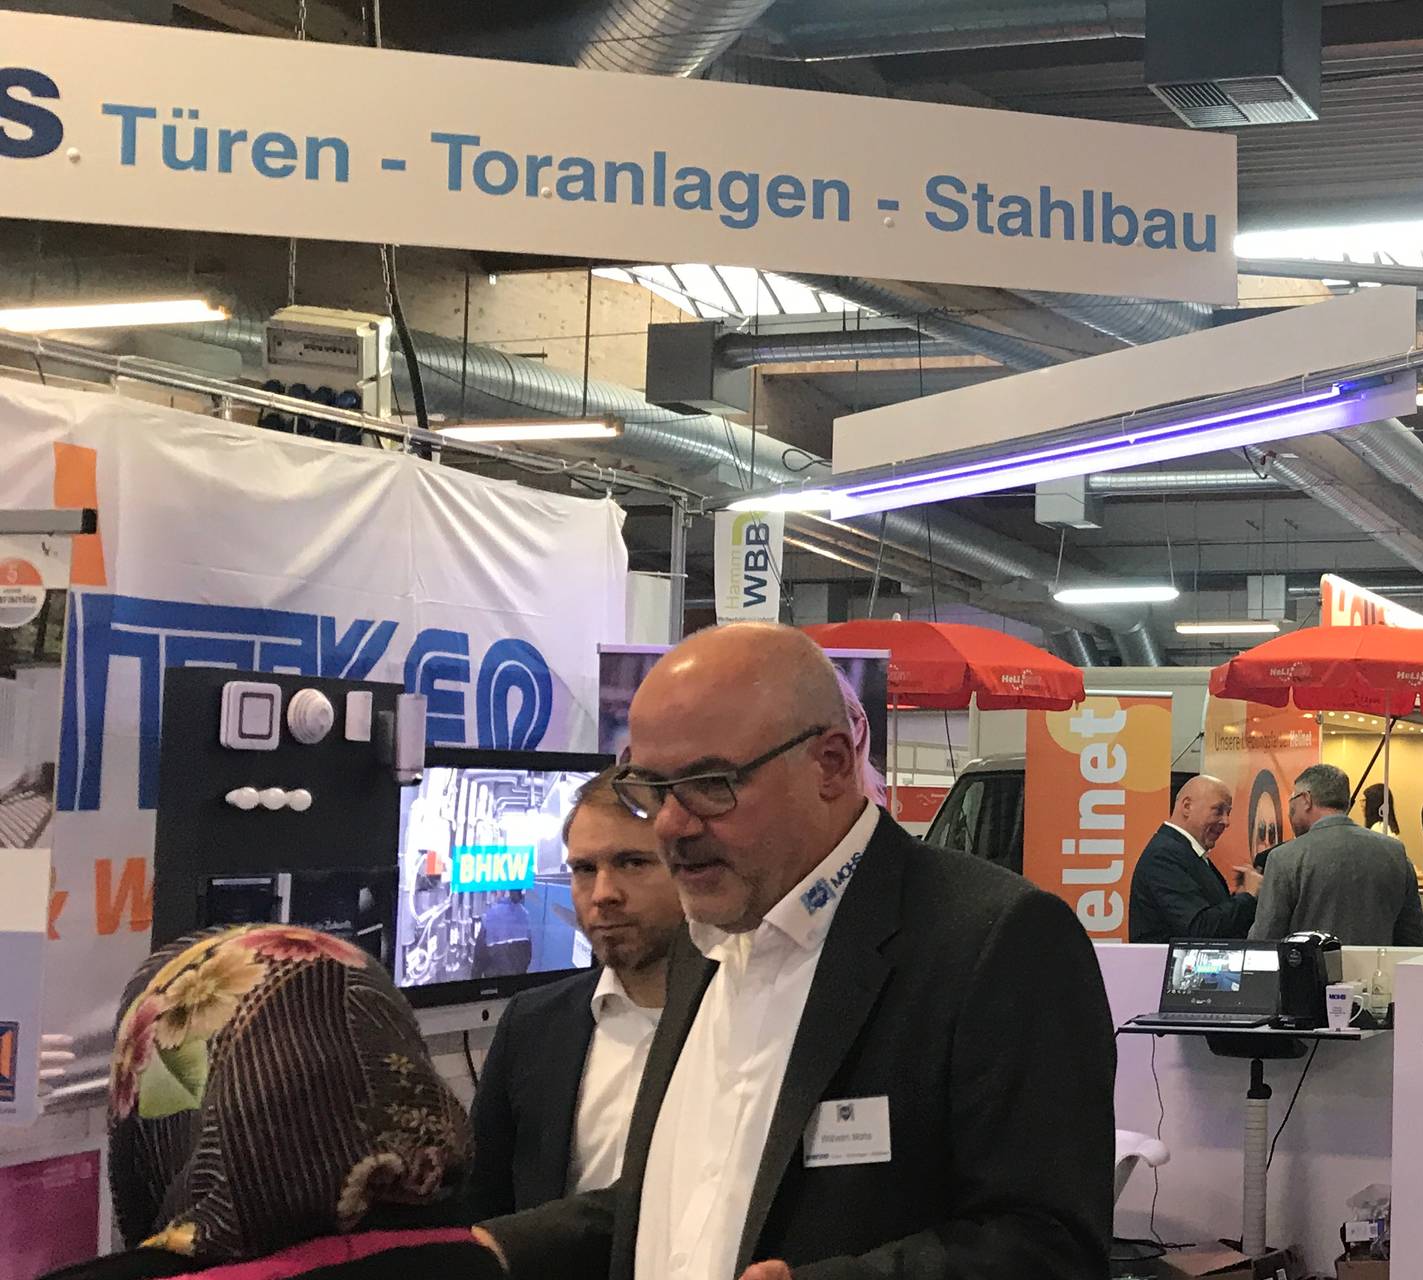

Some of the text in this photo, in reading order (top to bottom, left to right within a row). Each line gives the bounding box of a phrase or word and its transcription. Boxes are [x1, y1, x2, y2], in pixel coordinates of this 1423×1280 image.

[102, 103, 350, 183] Türen
[431, 131, 850, 230] Toranlagen
[925, 174, 1217, 253] Stahlbau
[743, 523, 769, 608] WBB
[459, 852, 531, 884] BHKW
[1061, 709, 1127, 943] elinet
